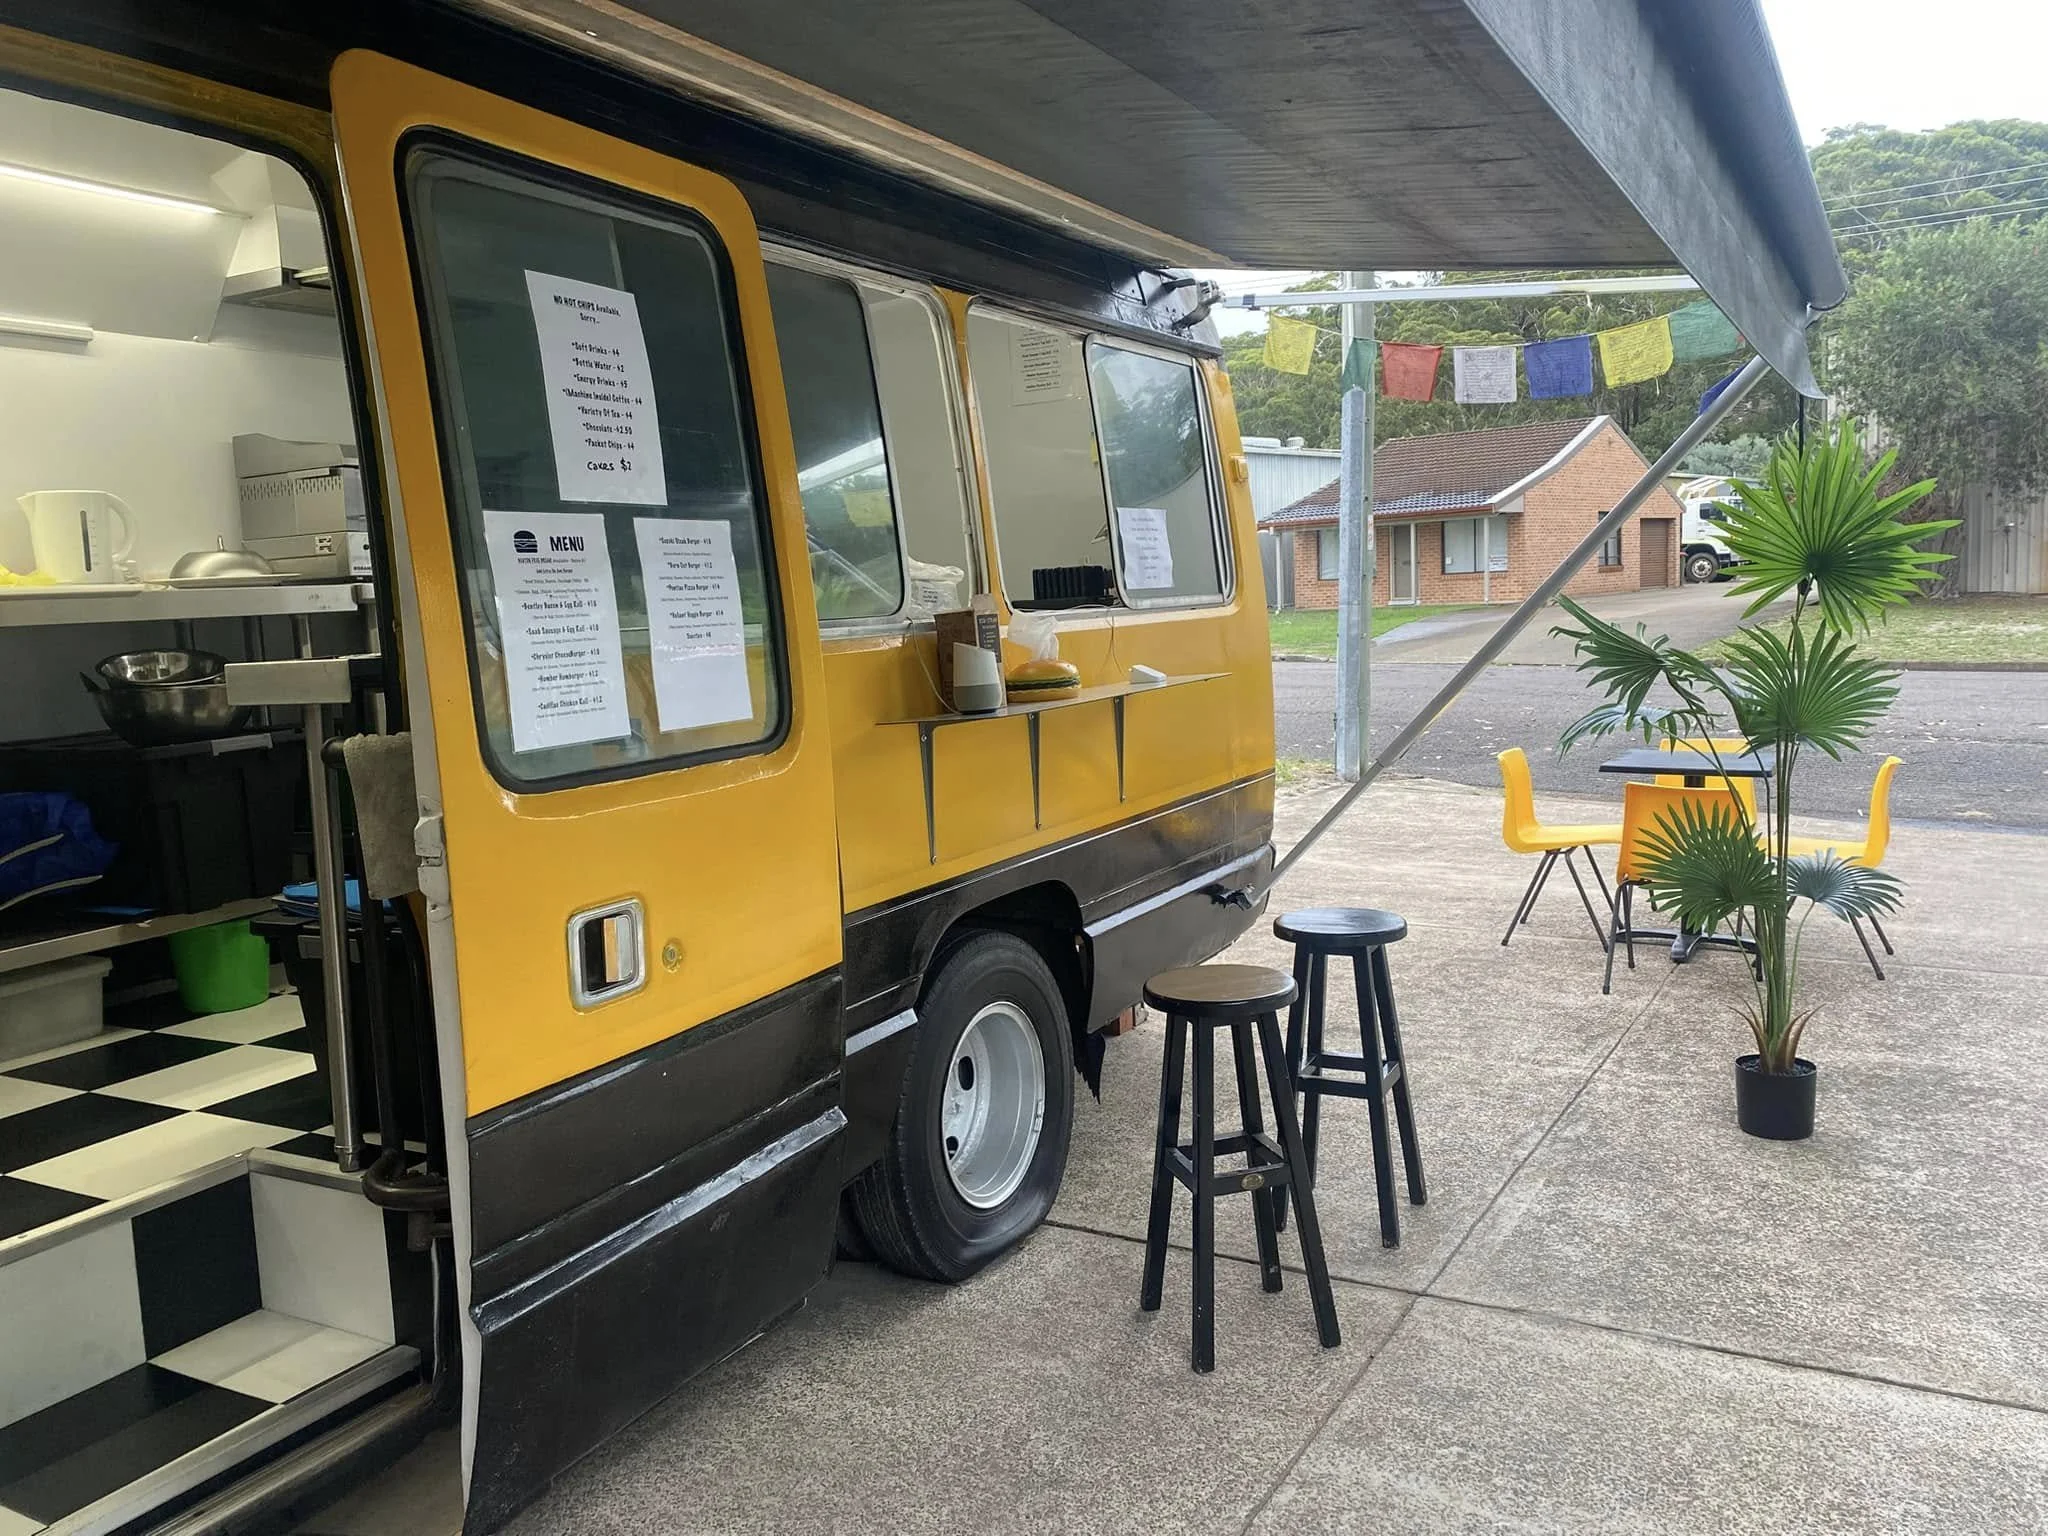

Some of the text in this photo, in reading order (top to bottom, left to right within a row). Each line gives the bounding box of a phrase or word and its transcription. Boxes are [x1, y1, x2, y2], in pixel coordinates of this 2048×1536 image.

[554, 295, 562, 304] NO
[563, 297, 577, 307] HOT
[578, 300, 595, 311] CHIPS
[589, 344, 607, 355] Drinks
[594, 361, 611, 371] Water
[597, 377, 615, 387] Drinks
[621, 380, 627, 388] $5
[612, 394, 630, 404] Coffee
[635, 397, 642, 405] $4
[603, 408, 609, 417] Of
[611, 410, 620, 418] Tea
[626, 411, 632, 419] $4
[608, 440, 622, 451] Chips
[627, 442, 634, 450] $4
[620, 456, 632, 472] $2
[549, 536, 584, 552] MENU
[686, 538, 700, 546] Burger
[688, 562, 700, 570] Burger
